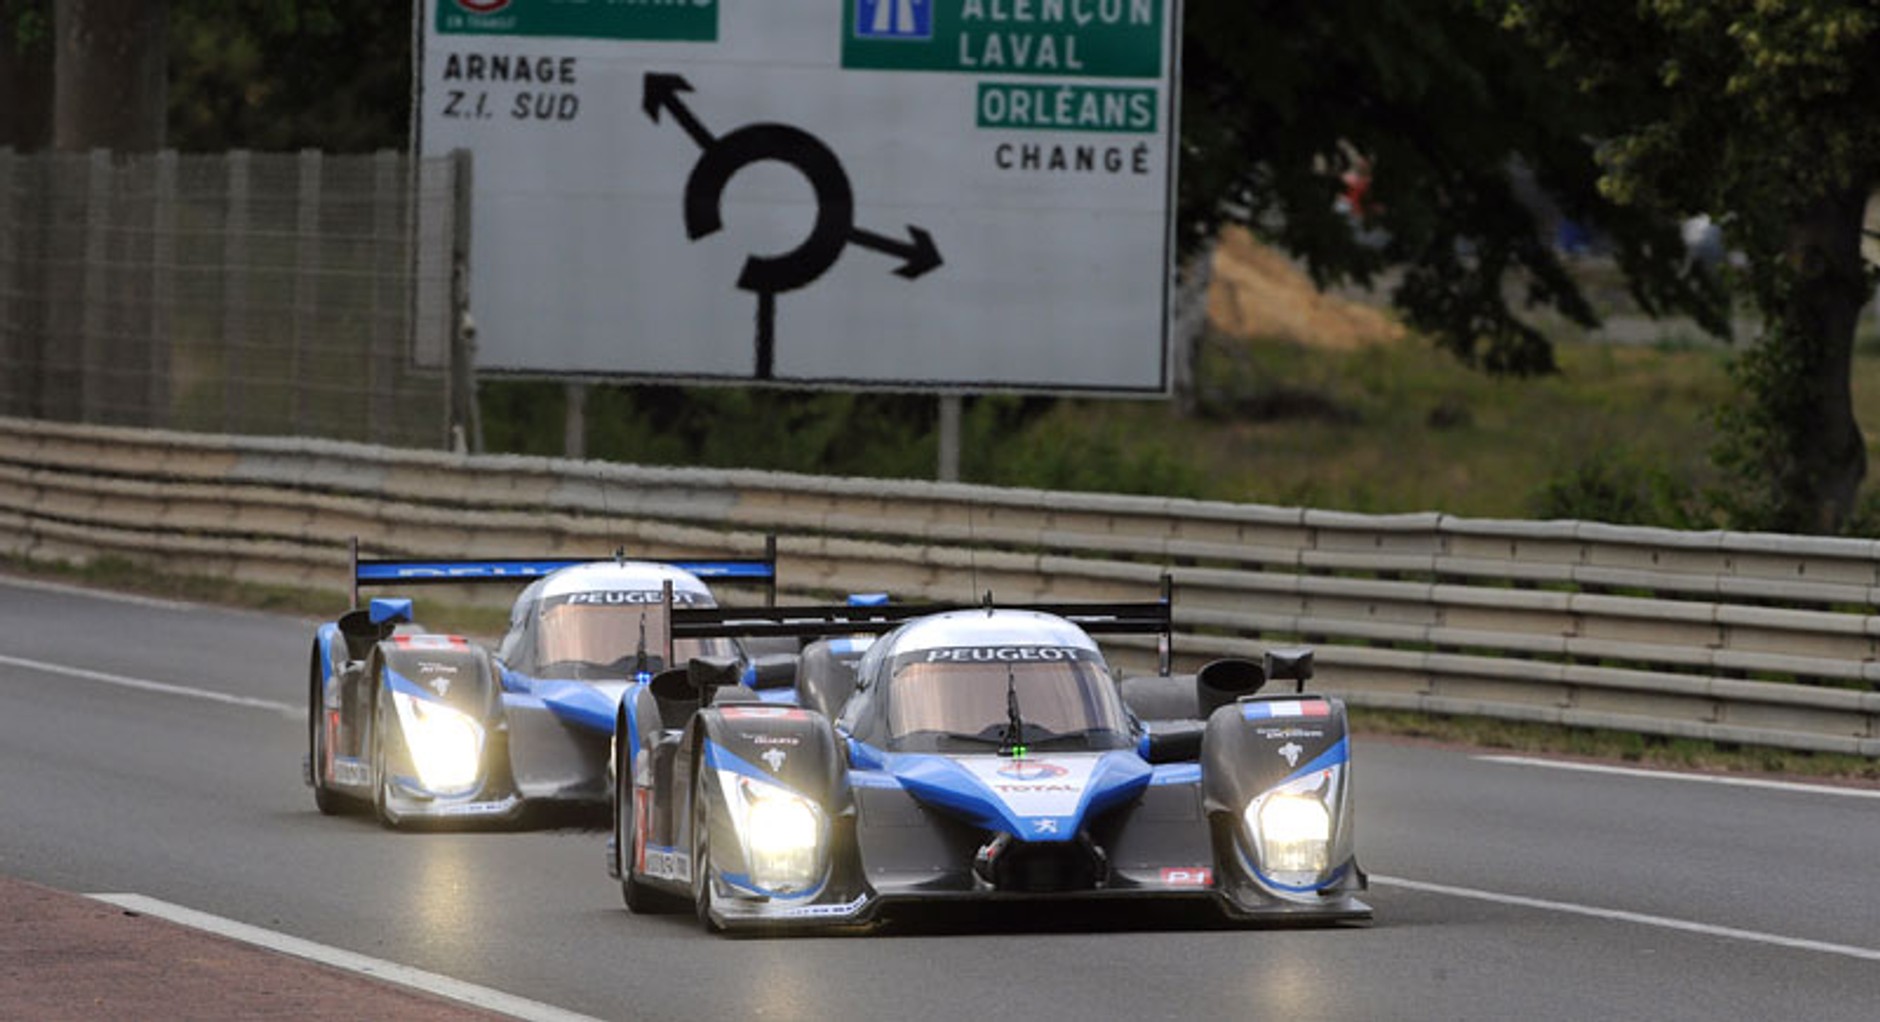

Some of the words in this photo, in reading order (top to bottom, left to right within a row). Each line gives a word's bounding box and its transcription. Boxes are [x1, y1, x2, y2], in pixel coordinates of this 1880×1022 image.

[959, 32, 1083, 69] LAVAL
[443, 54, 577, 84] ARNAGE
[511, 92, 580, 121] SUD
[983, 85, 1151, 127] ORLÉANS
[994, 142, 1149, 174] CHANGÉ
[927, 648, 1078, 662] PEUGEOT
